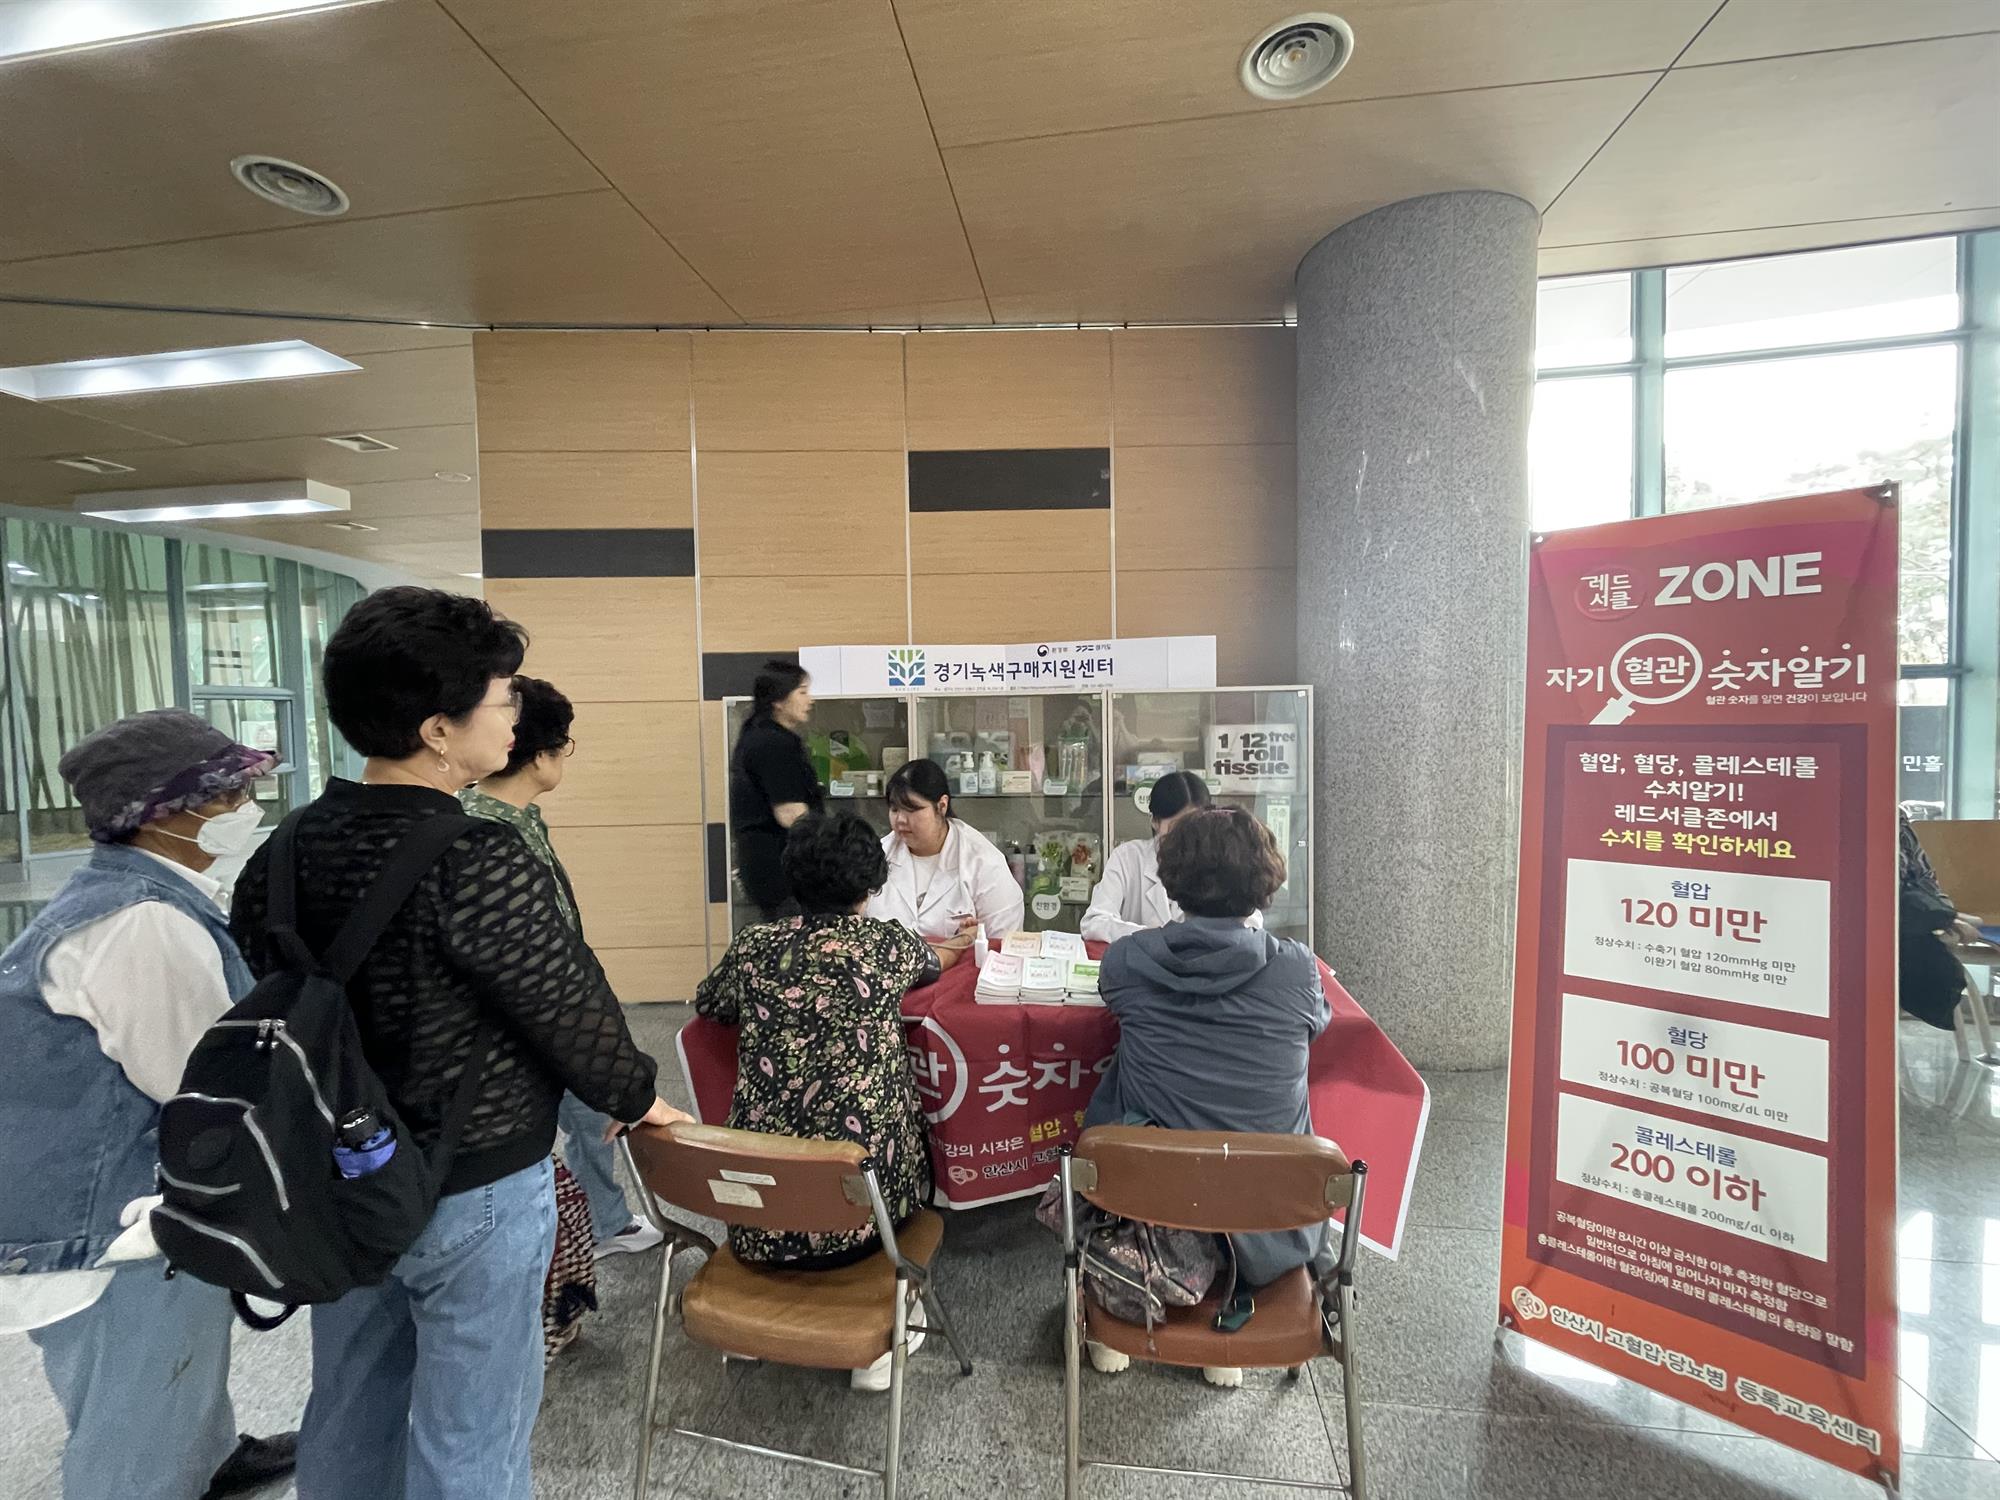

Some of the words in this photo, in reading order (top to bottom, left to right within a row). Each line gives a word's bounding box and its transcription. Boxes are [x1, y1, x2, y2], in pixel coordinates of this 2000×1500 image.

[1581, 574, 1632, 590] 레드
[1654, 552, 1823, 606] ZONE
[1589, 591, 1640, 610] 서클
[933, 657, 1114, 683] 경기녹색구매지원센터
[1546, 666, 1604, 693] 자기
[1624, 655, 1691, 685] 혈관
[1707, 643, 1866, 691] 숫자알기
[1705, 695, 1726, 705] 혈관
[1728, 694, 1759, 705] 숫자를
[1762, 694, 1783, 705] 알면
[1786, 693, 1819, 704] 건강이
[1821, 691, 1868, 703] 보입니다
[1218, 732, 1229, 749] 1
[1240, 732, 1268, 749] 12
[1269, 731, 1296, 743] free
[1243, 745, 1285, 762] roll
[1213, 759, 1290, 776] tissue
[1579, 752, 1626, 775] 혈압,
[1633, 753, 1684, 777] 혈당,
[1692, 755, 1819, 779] 콜레스테롤
[1644, 780, 1744, 802] 수치알기!
[1614, 804, 1778, 831] 레드서클존에서
[1600, 828, 1665, 851] 수치를
[1672, 832, 1796, 859] 확인하세요
[1671, 880, 1711, 901] 혈압
[1620, 898, 1678, 928] 120
[1689, 906, 1768, 943] 미만
[1594, 935, 1635, 950] 정상수치
[1645, 943, 1677, 956] 수축기
[1680, 947, 1702, 960] 혈압
[1706, 952, 1768, 970] 120mmHg
[1772, 961, 1796, 973] 미만
[1644, 956, 1677, 969] 이완기
[1680, 960, 1702, 973] 혈압
[1705, 965, 1760, 983] 80mmHg
[1763, 973, 1788, 986] 미만
[1668, 1026, 1708, 1050] 혈당
[1617, 1040, 1675, 1075] 100
[1686, 1054, 1766, 1099] 미만
[1598, 1071, 1640, 1089] 정상수치
[1649, 1082, 1693, 1101] 공복혈당
[1697, 1093, 1761, 1117] 100mg/dL
[1764, 1109, 1789, 1123] 미만
[979, 1136, 1025, 1155] 시작은
[1635, 1125, 1738, 1168] 콜레스테롤
[982, 1157, 1028, 1180] 안산시
[1610, 1142, 1675, 1183] 200
[1686, 1165, 1767, 1212] 이하
[1581, 1172, 1622, 1194] 정상수치
[1632, 1187, 1698, 1216] 총콜레스테롤
[1701, 1208, 1766, 1237] 200mg/dL
[1769, 1228, 1795, 1245] 이하
[1556, 1210, 1618, 1239] 공복혈당이란
[1618, 1231, 1647, 1250] 8시간
[1649, 1241, 1671, 1257] 이상
[1673, 1249, 1709, 1270] 금식한
[1710, 1260, 1735, 1277] 이후
[1736, 1269, 1775, 1292] 측정한
[1775, 1282, 1829, 1309] 혈당으로
[1586, 1234, 1638, 1261] 일반적으로
[1639, 1253, 1673, 1274] 아침에
[1675, 1264, 1722, 1288] 일어나자
[1723, 1280, 1748, 1299] 마자
[1750, 1289, 1789, 1313] 측정함
[1537, 1232, 1618, 1269] 총콜레스테롤이란
[1671, 1280, 1706, 1301] 포함된
[1707, 1291, 1781, 1328] 콜레스테롤의
[1783, 1317, 1823, 1342] 총량을
[1825, 1331, 1855, 1353] 말함
[1551, 1306, 1602, 1341] 안산시
[1606, 1328, 1727, 1391] 고혈압·당뇨병
[1735, 1377, 1880, 1455] 등록교육센터
